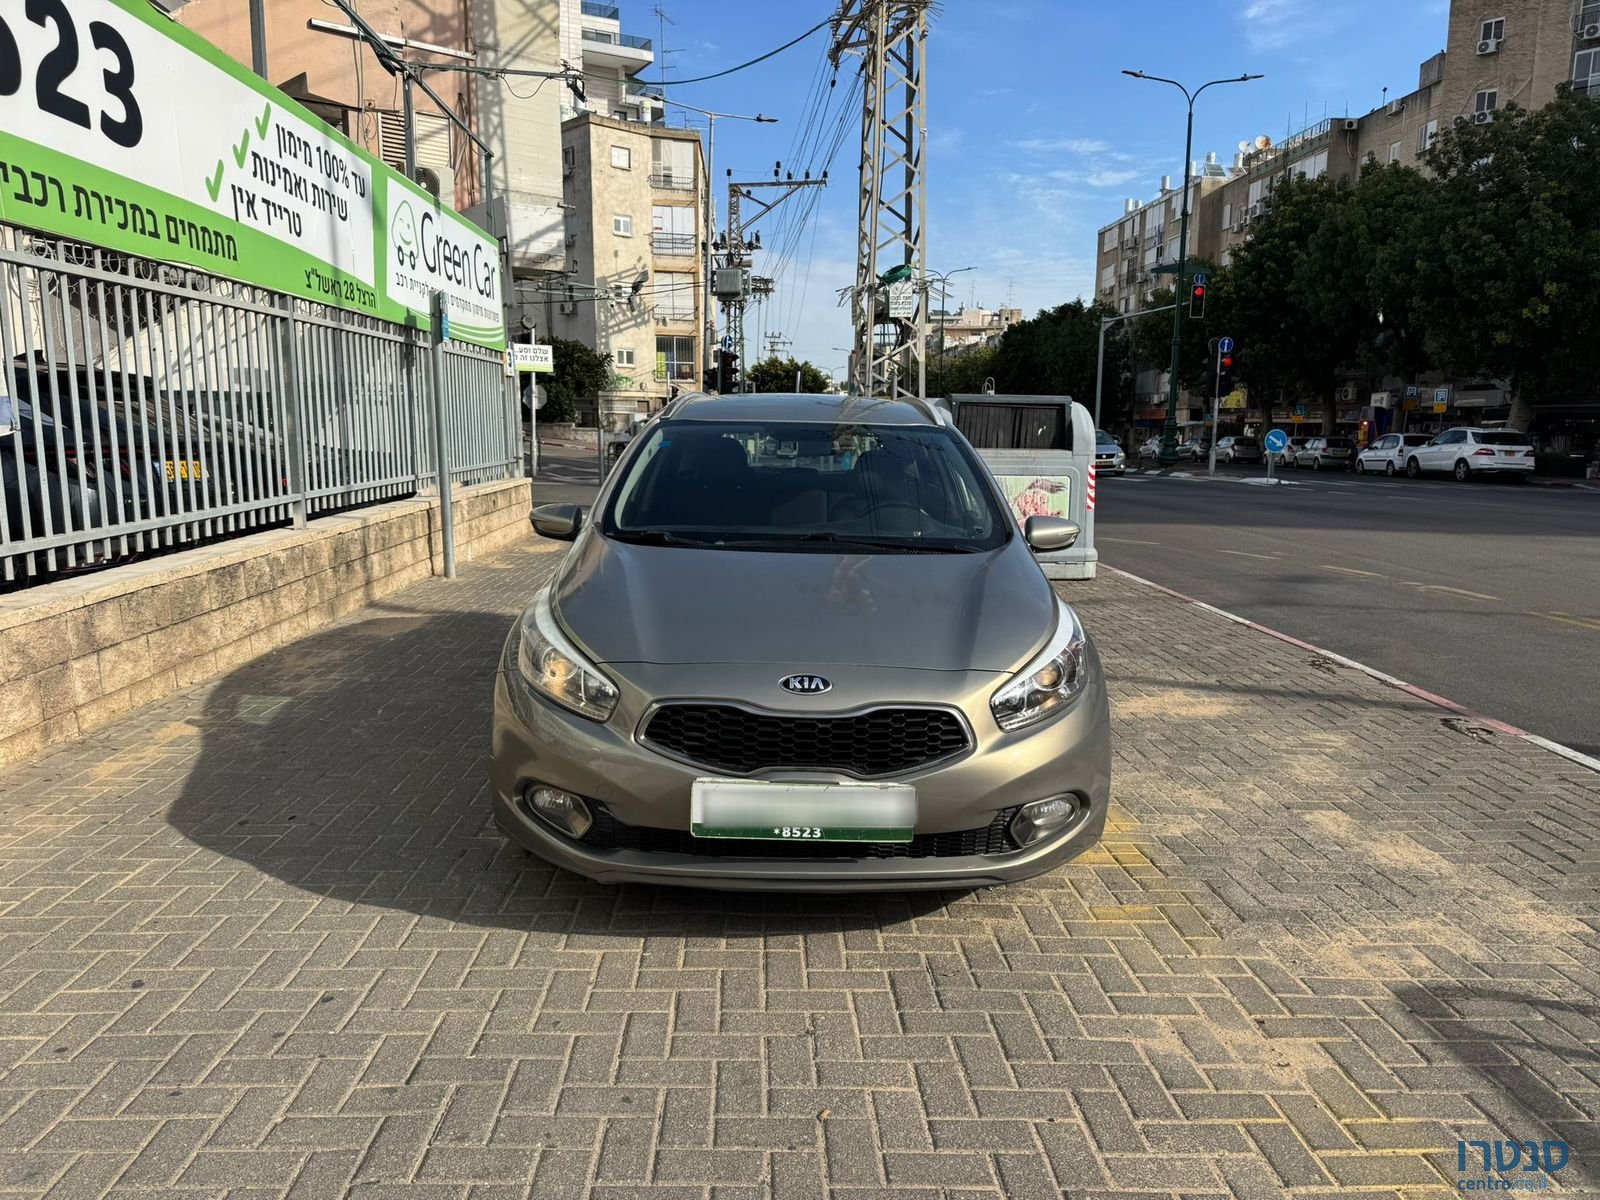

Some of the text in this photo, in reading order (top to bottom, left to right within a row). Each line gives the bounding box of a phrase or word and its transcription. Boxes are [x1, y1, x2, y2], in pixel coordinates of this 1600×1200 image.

[275, 123, 366, 199] עד 100% מימון
[251, 151, 348, 221] שירות ואמינות
[73, 184, 160, 239] במכירת
[231, 184, 302, 237] טרייד אין
[165, 214, 238, 261] מתמחים
[421, 211, 496, 300] Green Car
[343, 279, 355, 302] 28
[356, 283, 376, 309] הרצל
[395, 272, 408, 289] רכב
[529, 354, 549, 362] אצלנו
[533, 347, 549, 355] שלם
[788, 676, 825, 690] KIA
